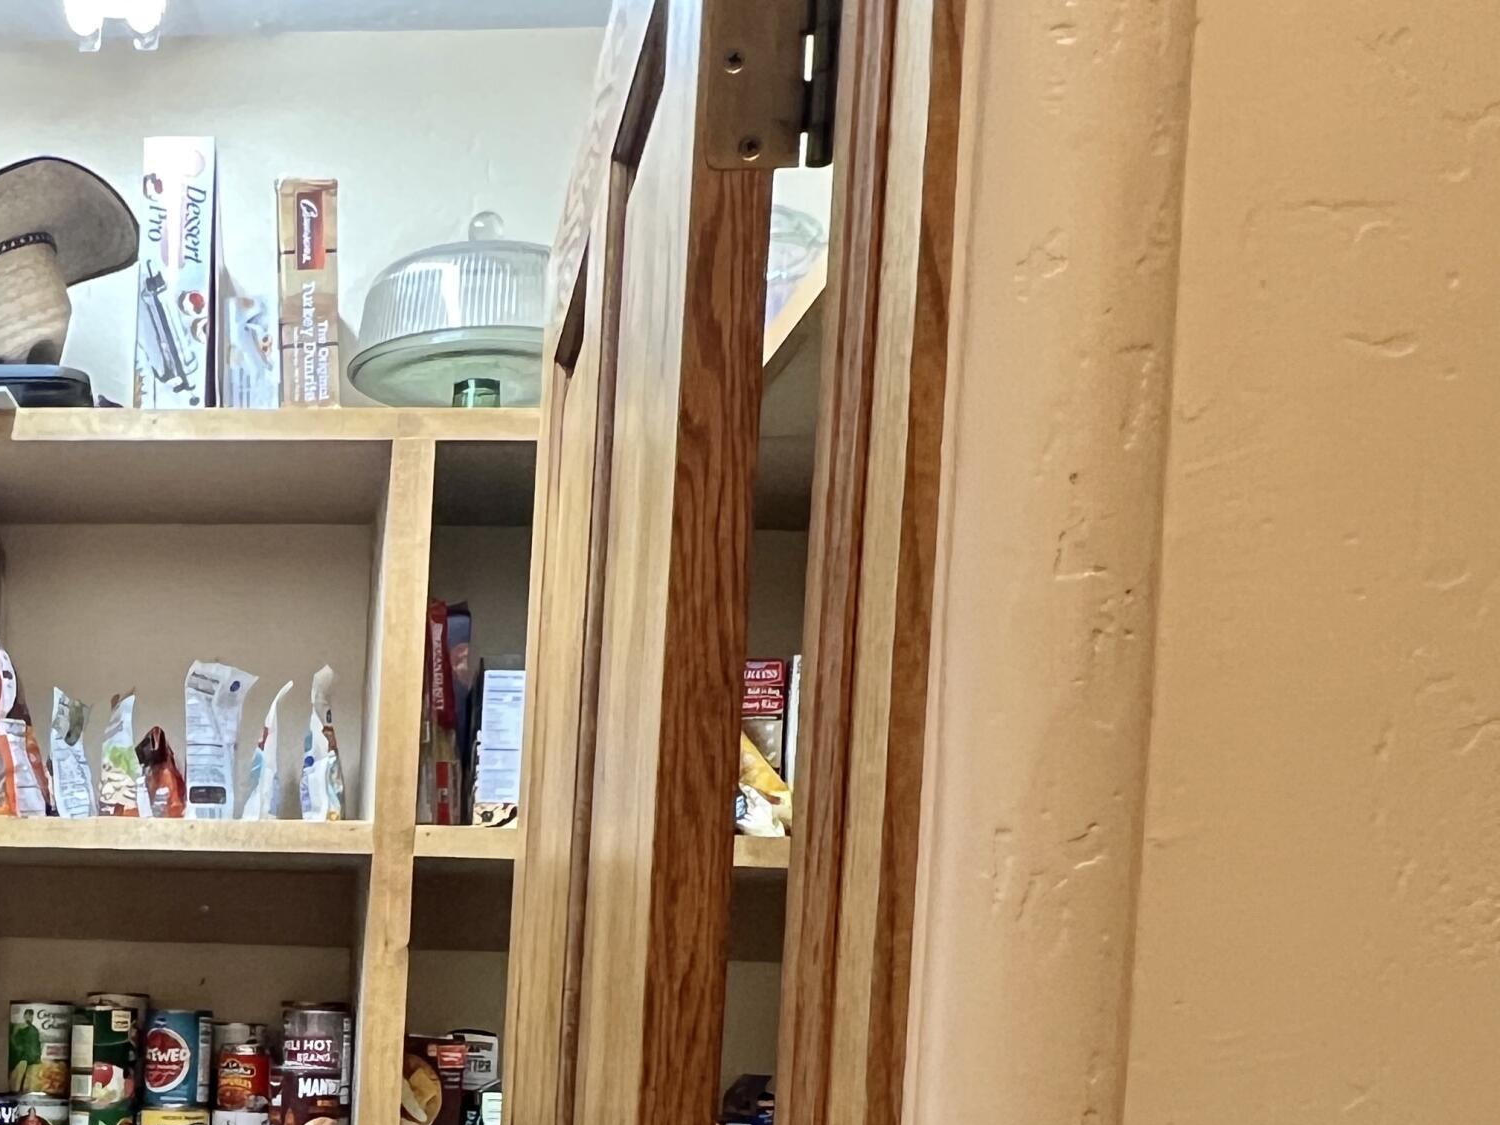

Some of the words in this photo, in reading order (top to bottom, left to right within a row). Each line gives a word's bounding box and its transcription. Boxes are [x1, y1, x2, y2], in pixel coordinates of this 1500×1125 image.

[147, 205, 168, 242] Pro
[184, 185, 207, 263] Dessert
[303, 1039, 332, 1051] HOT
